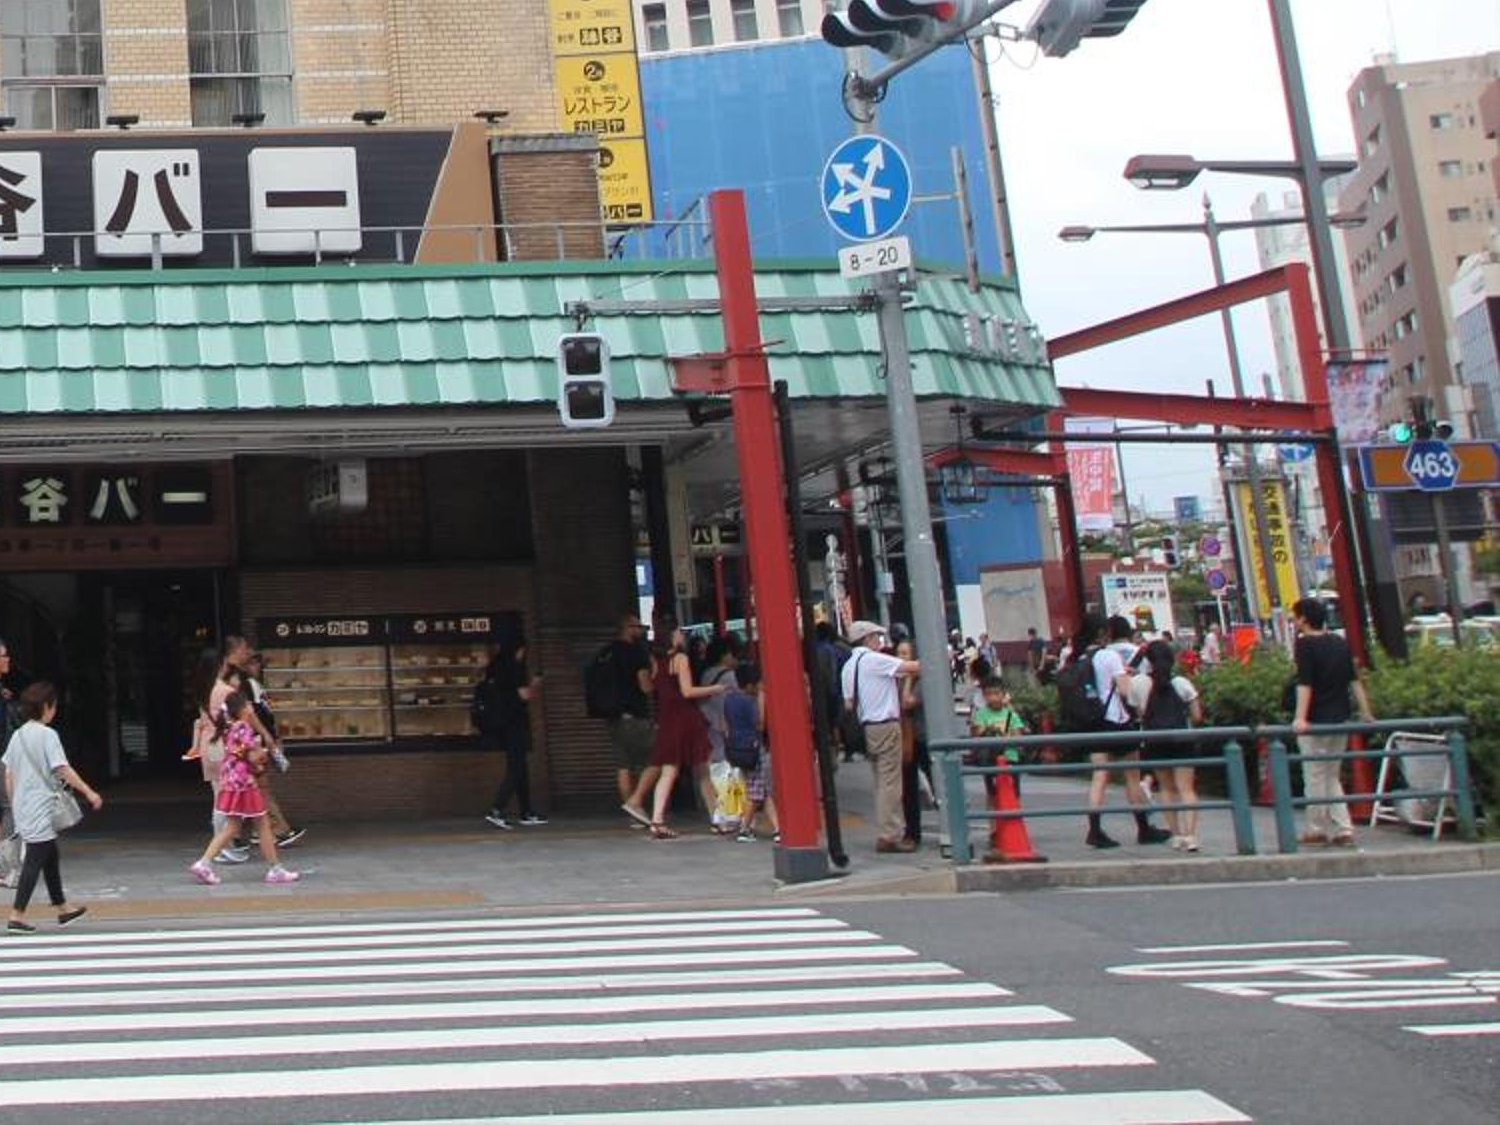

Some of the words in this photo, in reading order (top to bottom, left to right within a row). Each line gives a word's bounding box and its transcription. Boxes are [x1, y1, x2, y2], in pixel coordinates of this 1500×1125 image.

[563, 95, 631, 116] レストラン
[850, 245, 899, 272] 8-20
[1410, 452, 1455, 478] 463
